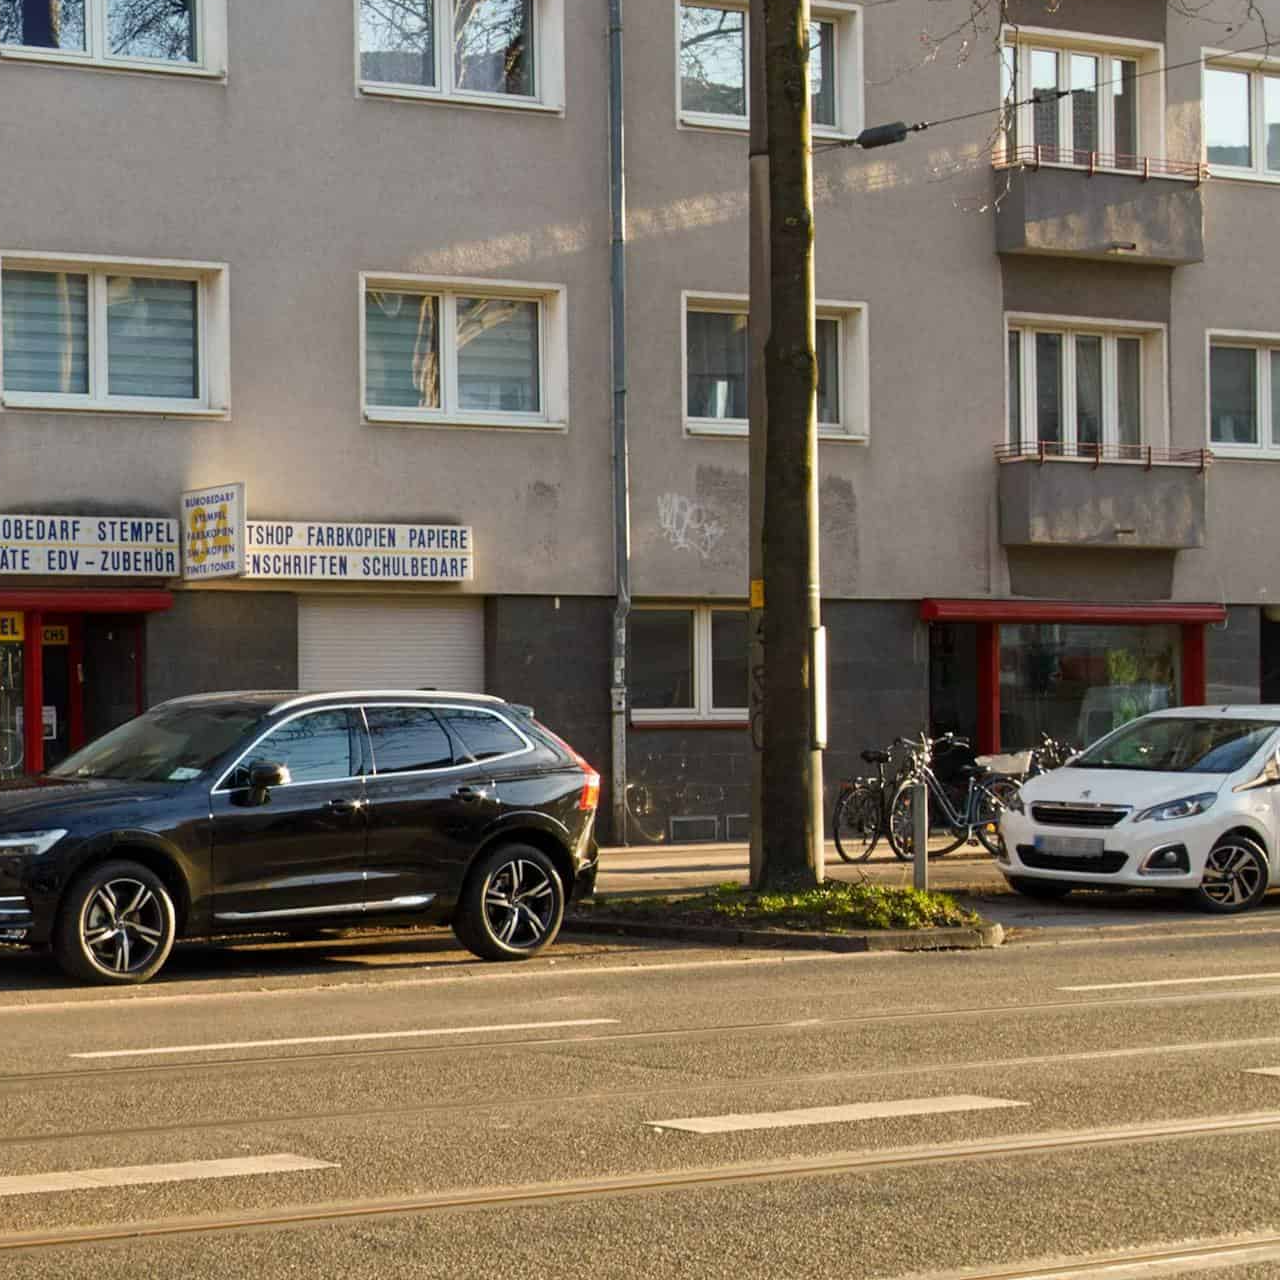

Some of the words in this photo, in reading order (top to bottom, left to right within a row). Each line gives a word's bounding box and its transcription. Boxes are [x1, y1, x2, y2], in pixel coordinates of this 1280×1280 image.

[185, 492, 234, 508] BÜROBEDARF
[98, 520, 175, 543] STEMPEL
[307, 526, 397, 548] FARBKOPIEN
[408, 527, 468, 550] PAPIERE
[47, 549, 80, 571] EDV
[100, 548, 176, 572] ZUBEHÖR
[362, 556, 469, 578] SCHULBEDARF
